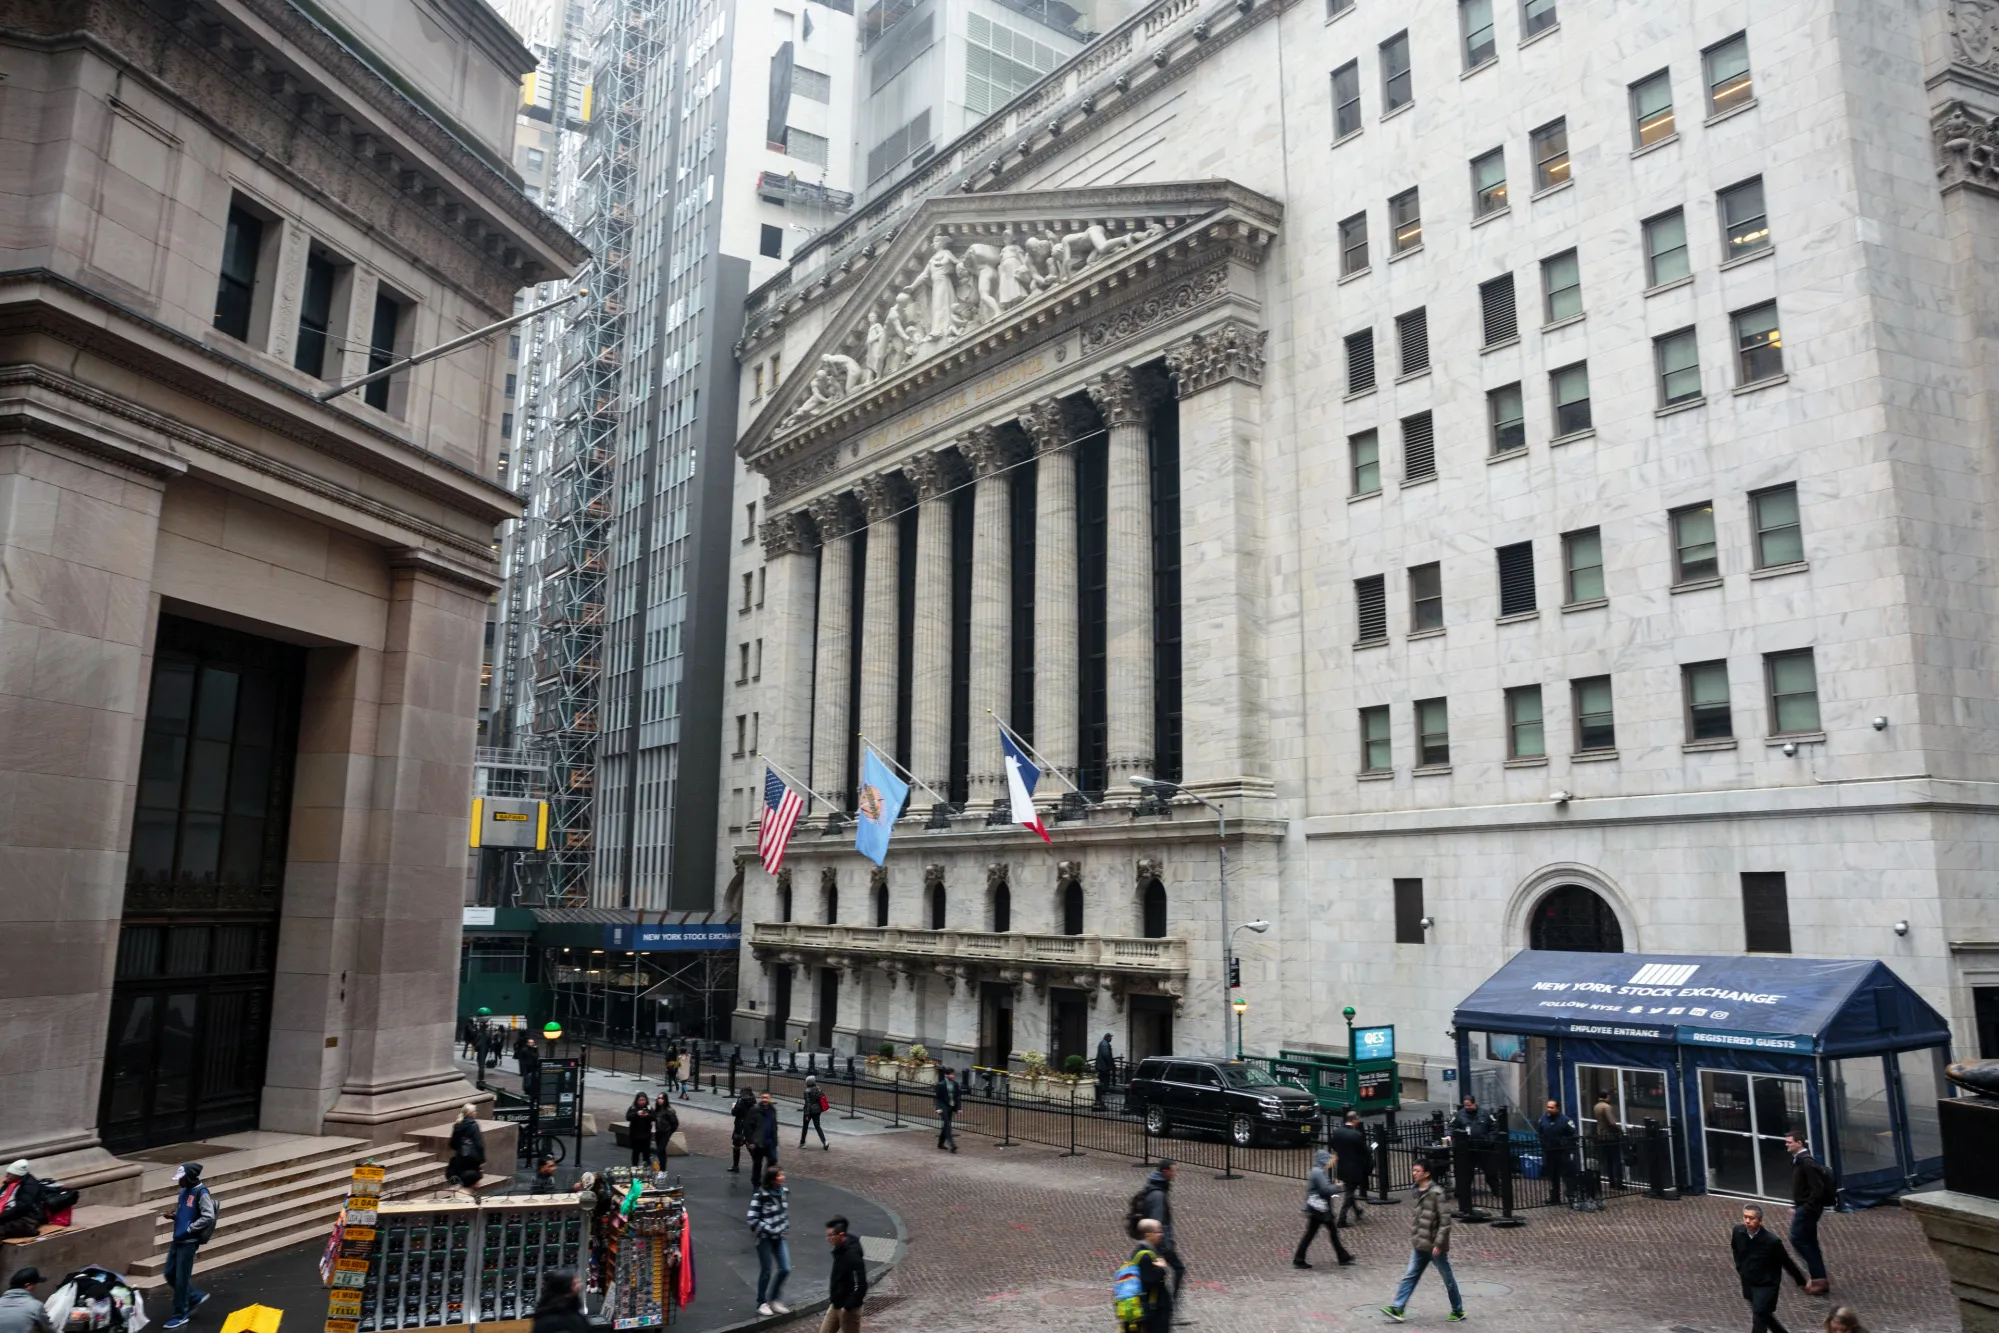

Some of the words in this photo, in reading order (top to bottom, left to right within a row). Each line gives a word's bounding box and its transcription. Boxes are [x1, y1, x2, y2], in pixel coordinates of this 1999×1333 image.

[867, 430, 889, 449] NEW
[896, 410, 924, 435] YORK
[931, 390, 968, 421] STOCK
[975, 356, 1045, 401] EXCHANGE
[642, 933, 661, 941] NEW
[662, 933, 682, 941] YORK
[708, 932, 742, 940] EXCHANG
[1531, 981, 1571, 991] NEW
[1572, 982, 1618, 994] YORK
[1617, 986, 1678, 997] STOCK
[1676, 987, 1787, 1004] EXCHANGE
[1538, 1000, 1589, 1009] FOLLOW
[1588, 1003, 1623, 1012] NYSE
[1570, 1024, 1613, 1035] EMPLOYEE
[1613, 1027, 1660, 1038] ENTRANCE
[1692, 1033, 1754, 1045] REGISTERED
[1755, 1038, 1796, 1049] GUESTS
[1274, 1064, 1300, 1075] Subway
[361, 1199, 378, 1207] DAD
